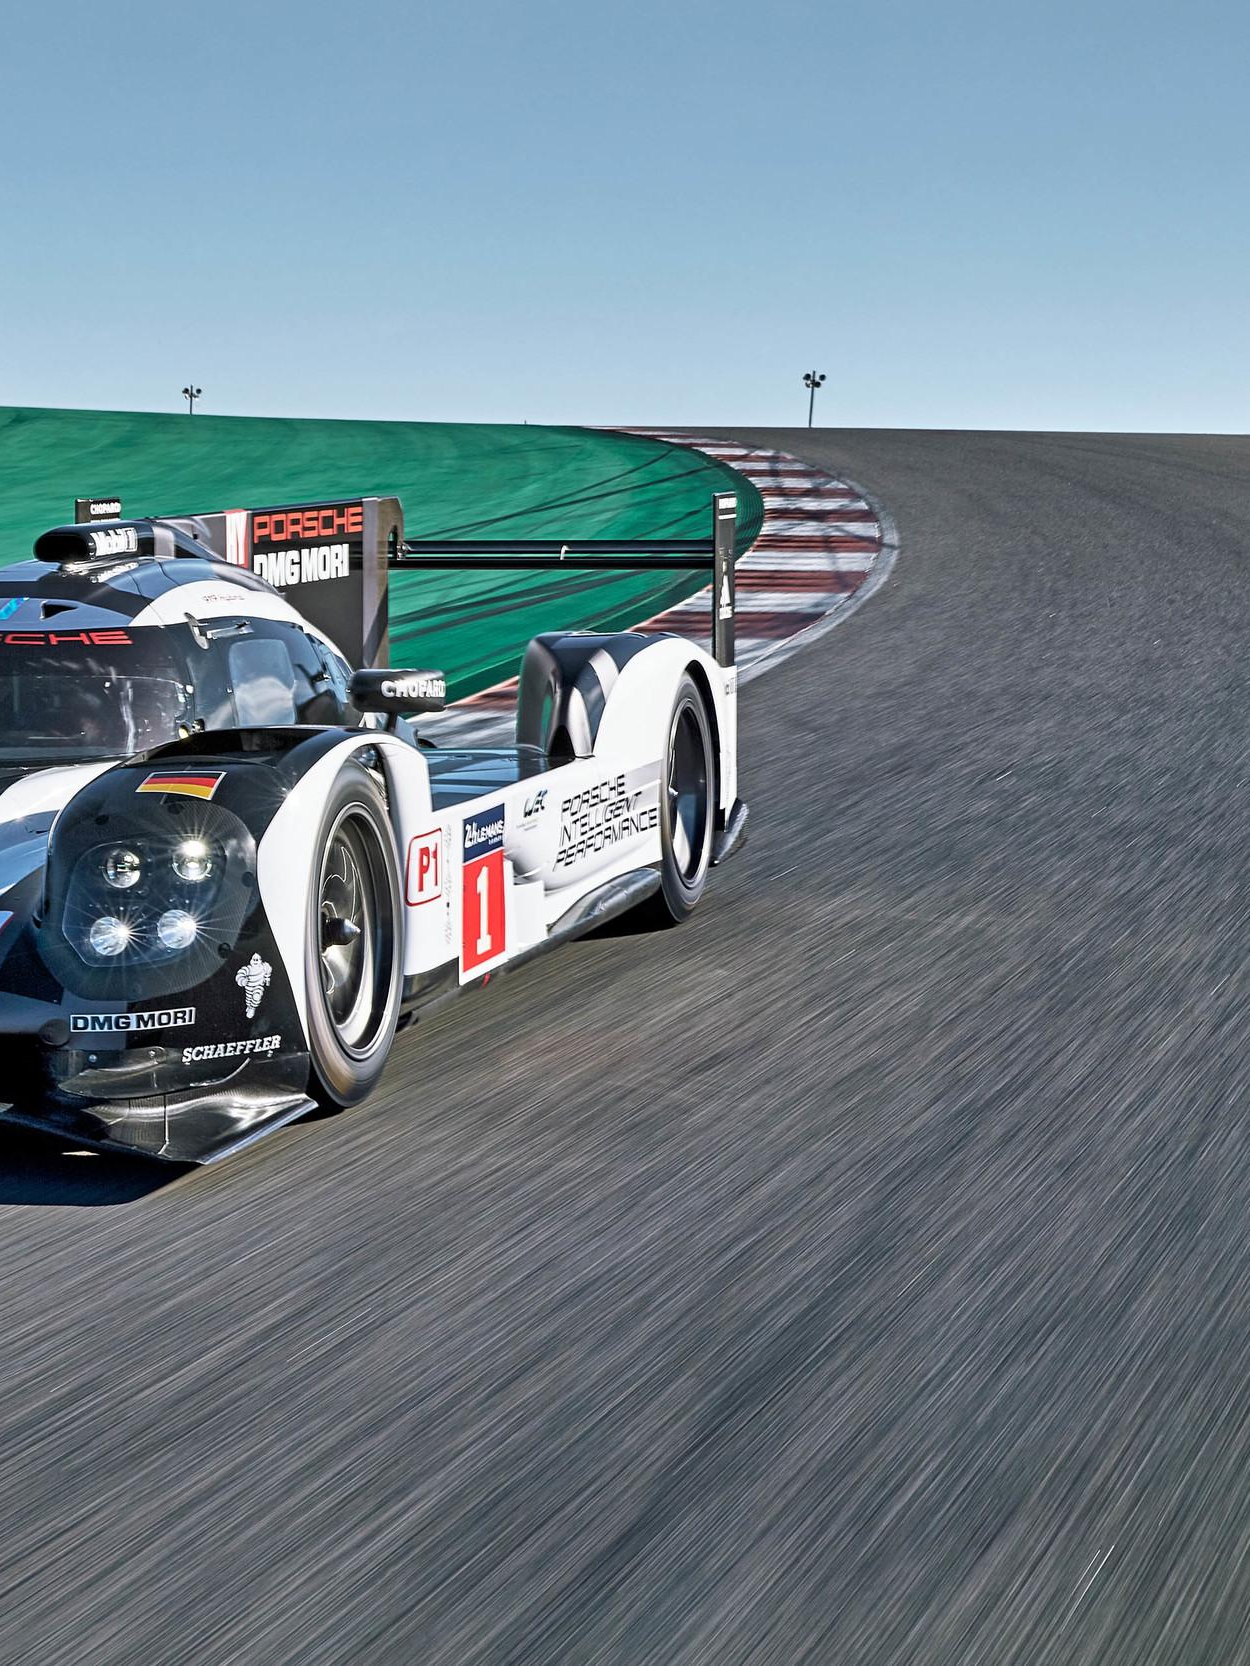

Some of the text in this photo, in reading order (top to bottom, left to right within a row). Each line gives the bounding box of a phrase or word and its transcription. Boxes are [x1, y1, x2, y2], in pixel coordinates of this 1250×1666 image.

[253, 506, 363, 544] PORSCHE
[253, 543, 350, 587] DMG MORI
[381, 679, 446, 698] CHOPARD
[560, 791, 643, 847] INTELLIGENT
[561, 774, 626, 822] PORSCHE
[552, 807, 658, 872] PERFORMANCE
[418, 842, 439, 892] P1
[476, 866, 492, 955] 1
[72, 1008, 193, 1031] DMG MORI
[182, 1034, 282, 1063] SCHAEFFLER
